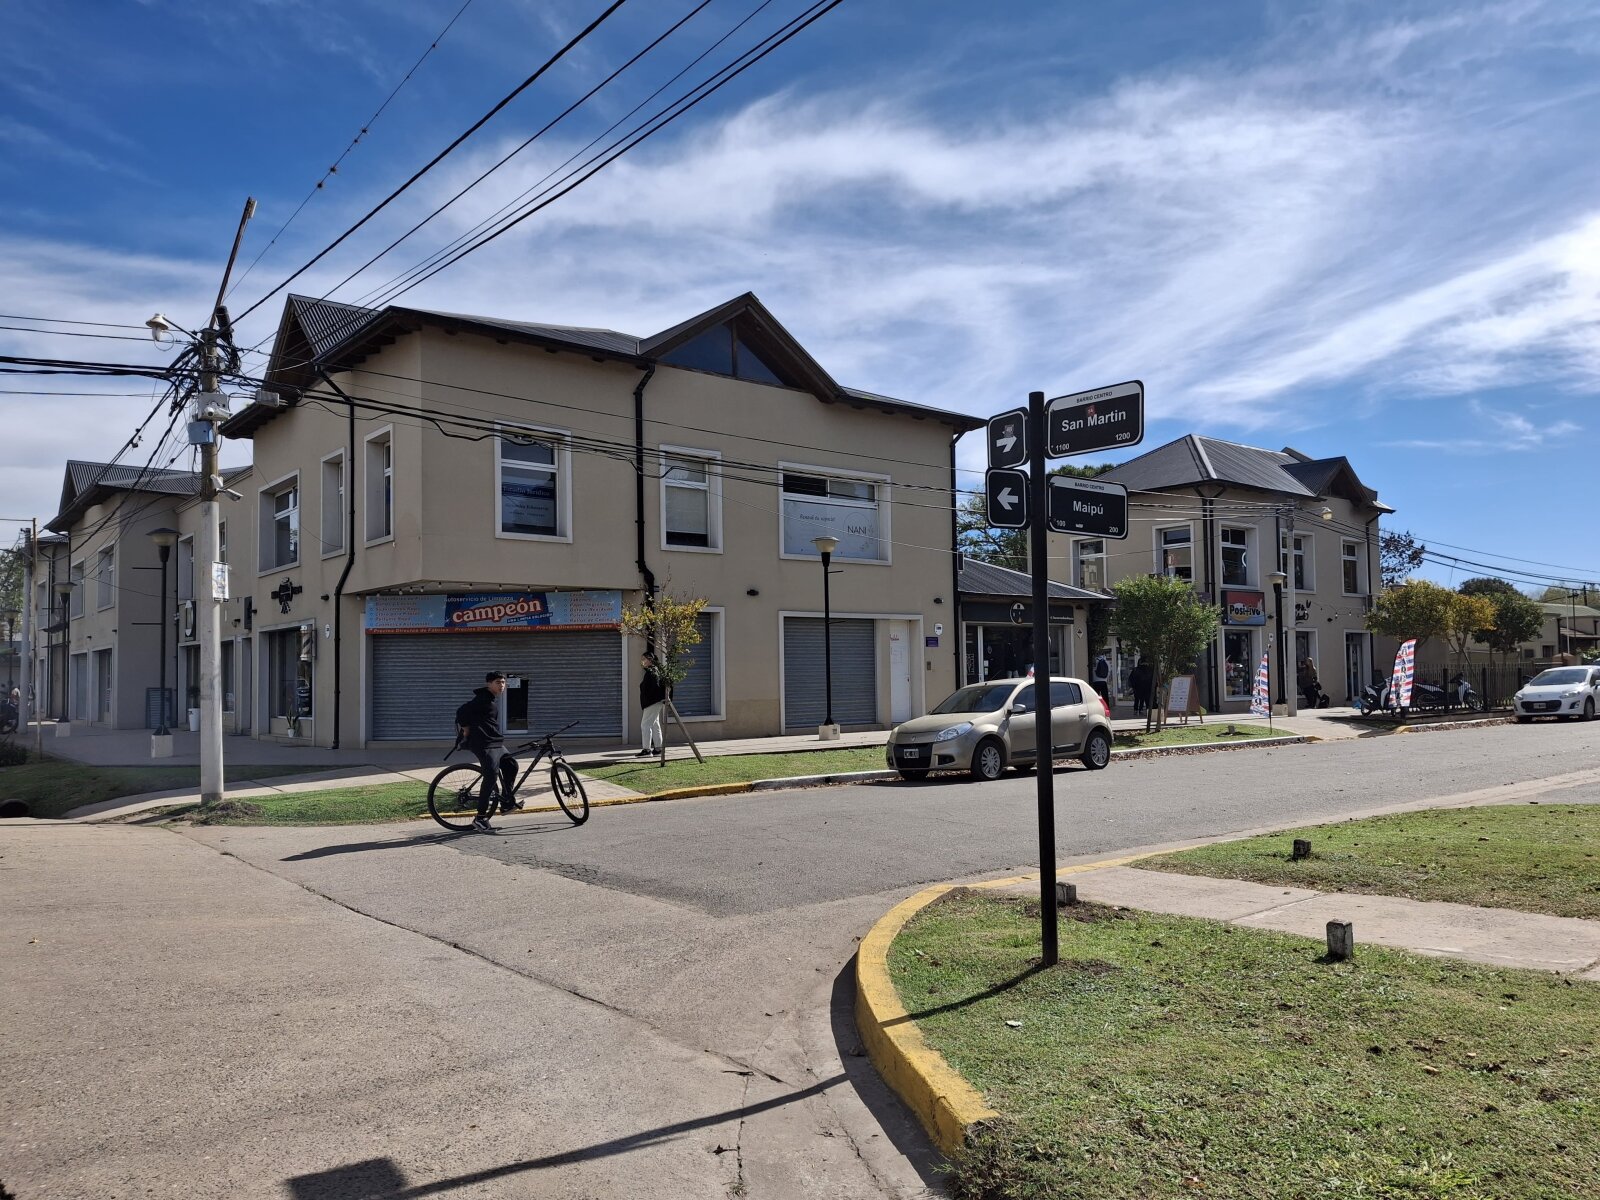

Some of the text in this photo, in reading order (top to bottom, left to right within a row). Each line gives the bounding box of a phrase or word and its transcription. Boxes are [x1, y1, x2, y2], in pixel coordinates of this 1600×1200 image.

[1076, 391, 1113, 403] BARRIO CENTRO
[1061, 410, 1126, 432] San Martin
[1115, 431, 1131, 441] 1200
[1055, 443, 1070, 452] 1100
[1073, 500, 1104, 517] Maipú
[847, 525, 867, 535] NANI
[452, 598, 543, 623] campeón
[1229, 604, 1261, 617] Positivo
